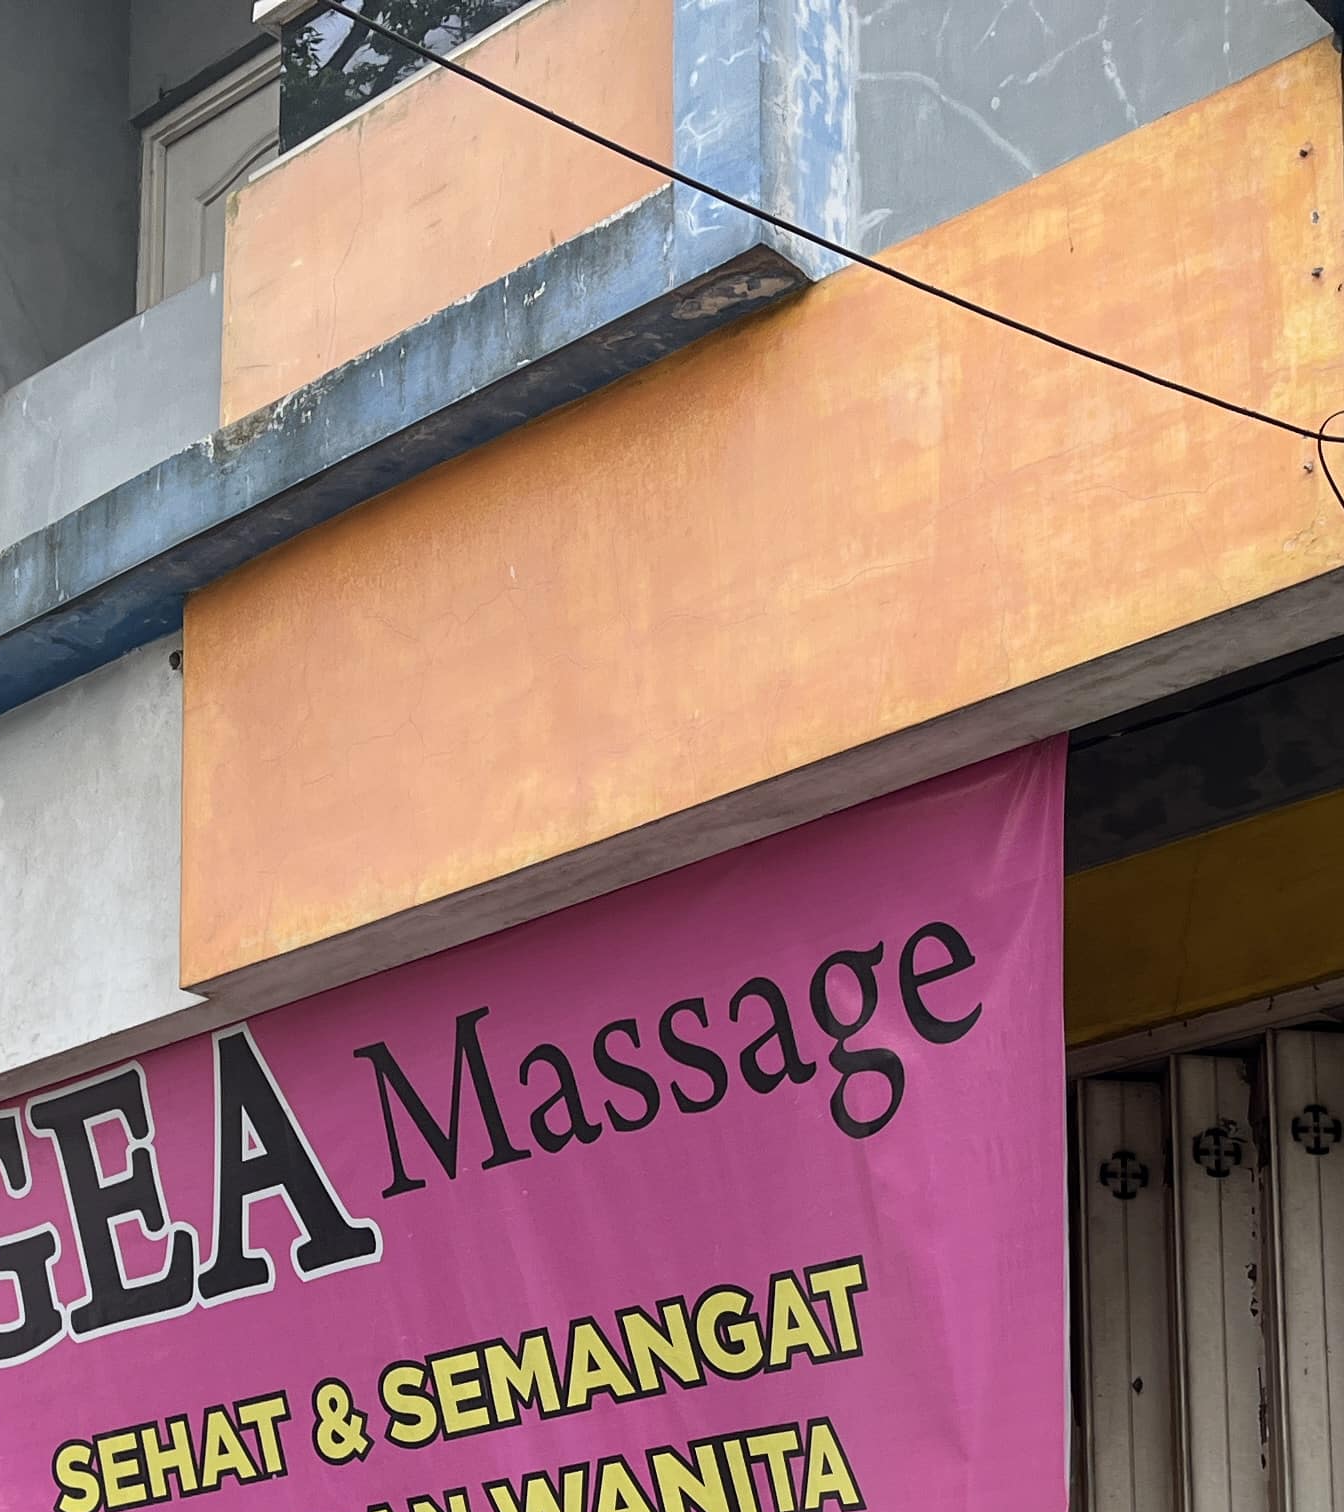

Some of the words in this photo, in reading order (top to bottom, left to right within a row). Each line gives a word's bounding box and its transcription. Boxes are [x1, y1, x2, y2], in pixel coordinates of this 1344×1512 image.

[353, 921, 985, 1199] Massage
[313, 1376, 373, 1464] &
[383, 1255, 869, 1446] SEMANGAT
